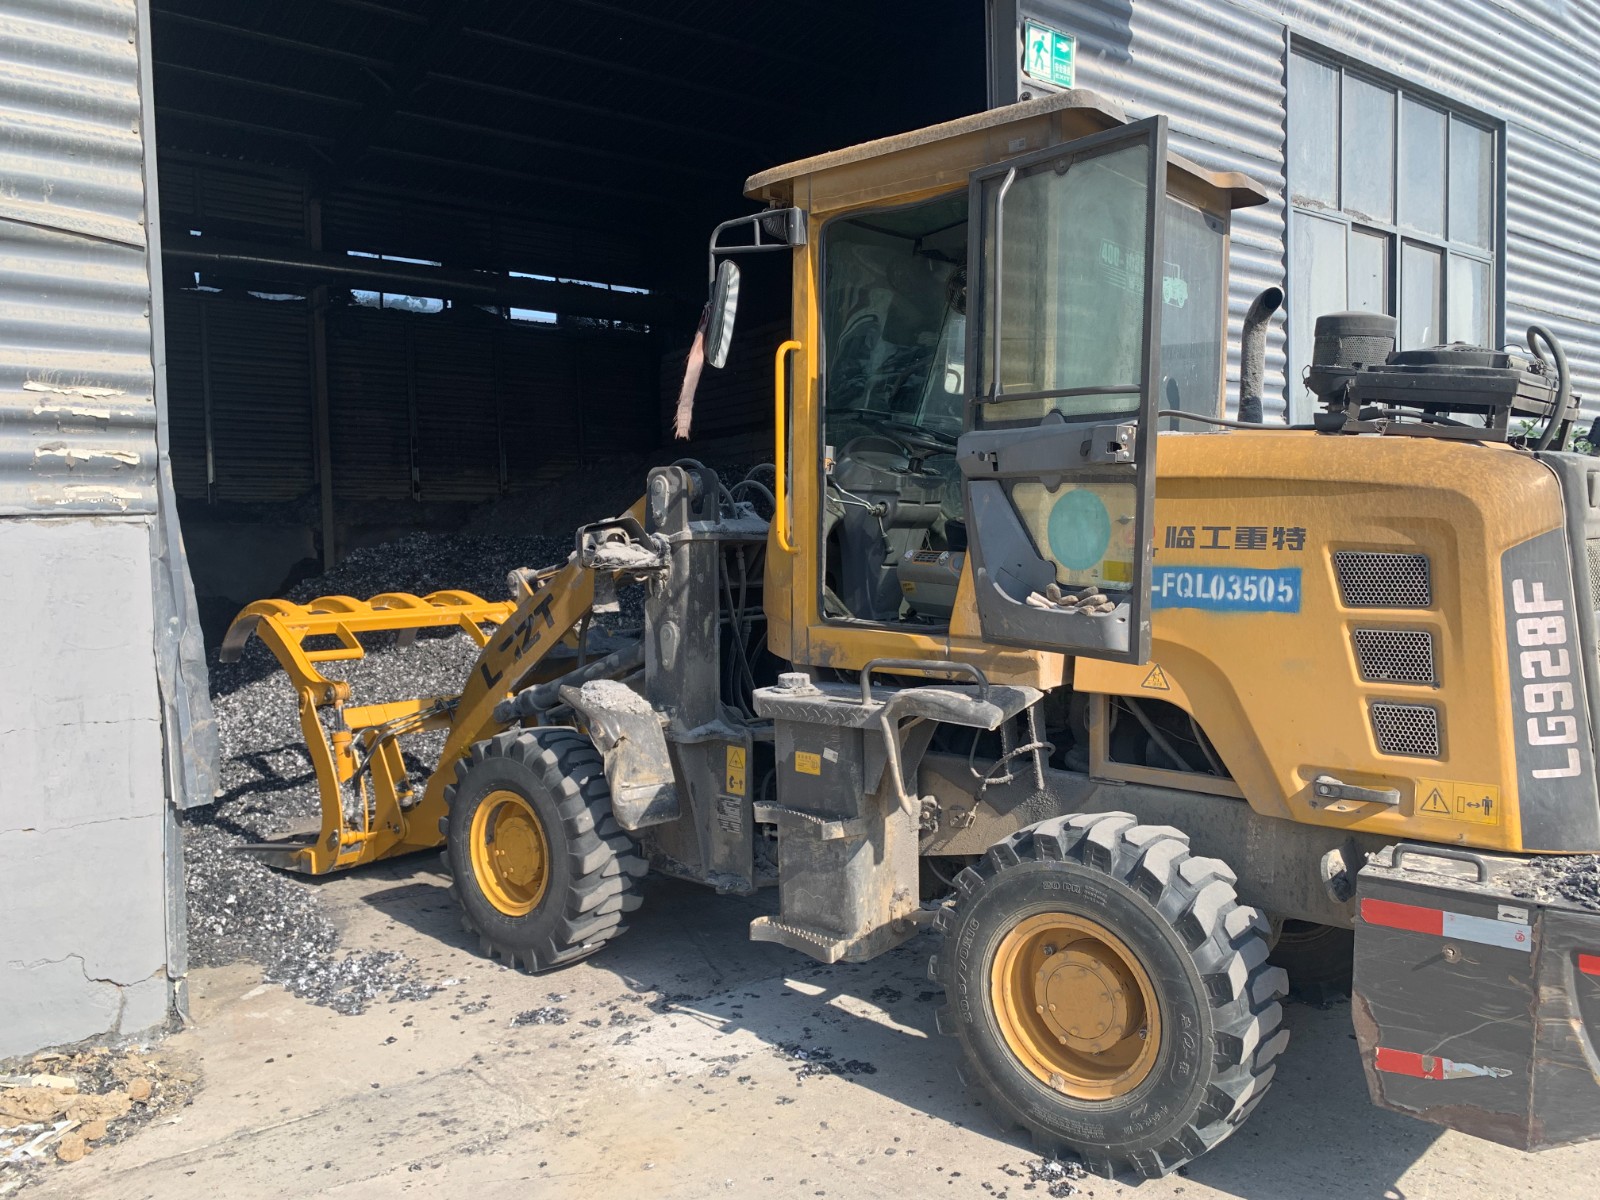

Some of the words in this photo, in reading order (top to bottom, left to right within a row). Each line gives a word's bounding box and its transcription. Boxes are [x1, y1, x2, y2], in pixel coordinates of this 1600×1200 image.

[1165, 526, 1306, 550] 临工重特
[1512, 579, 1581, 779] LG928F
